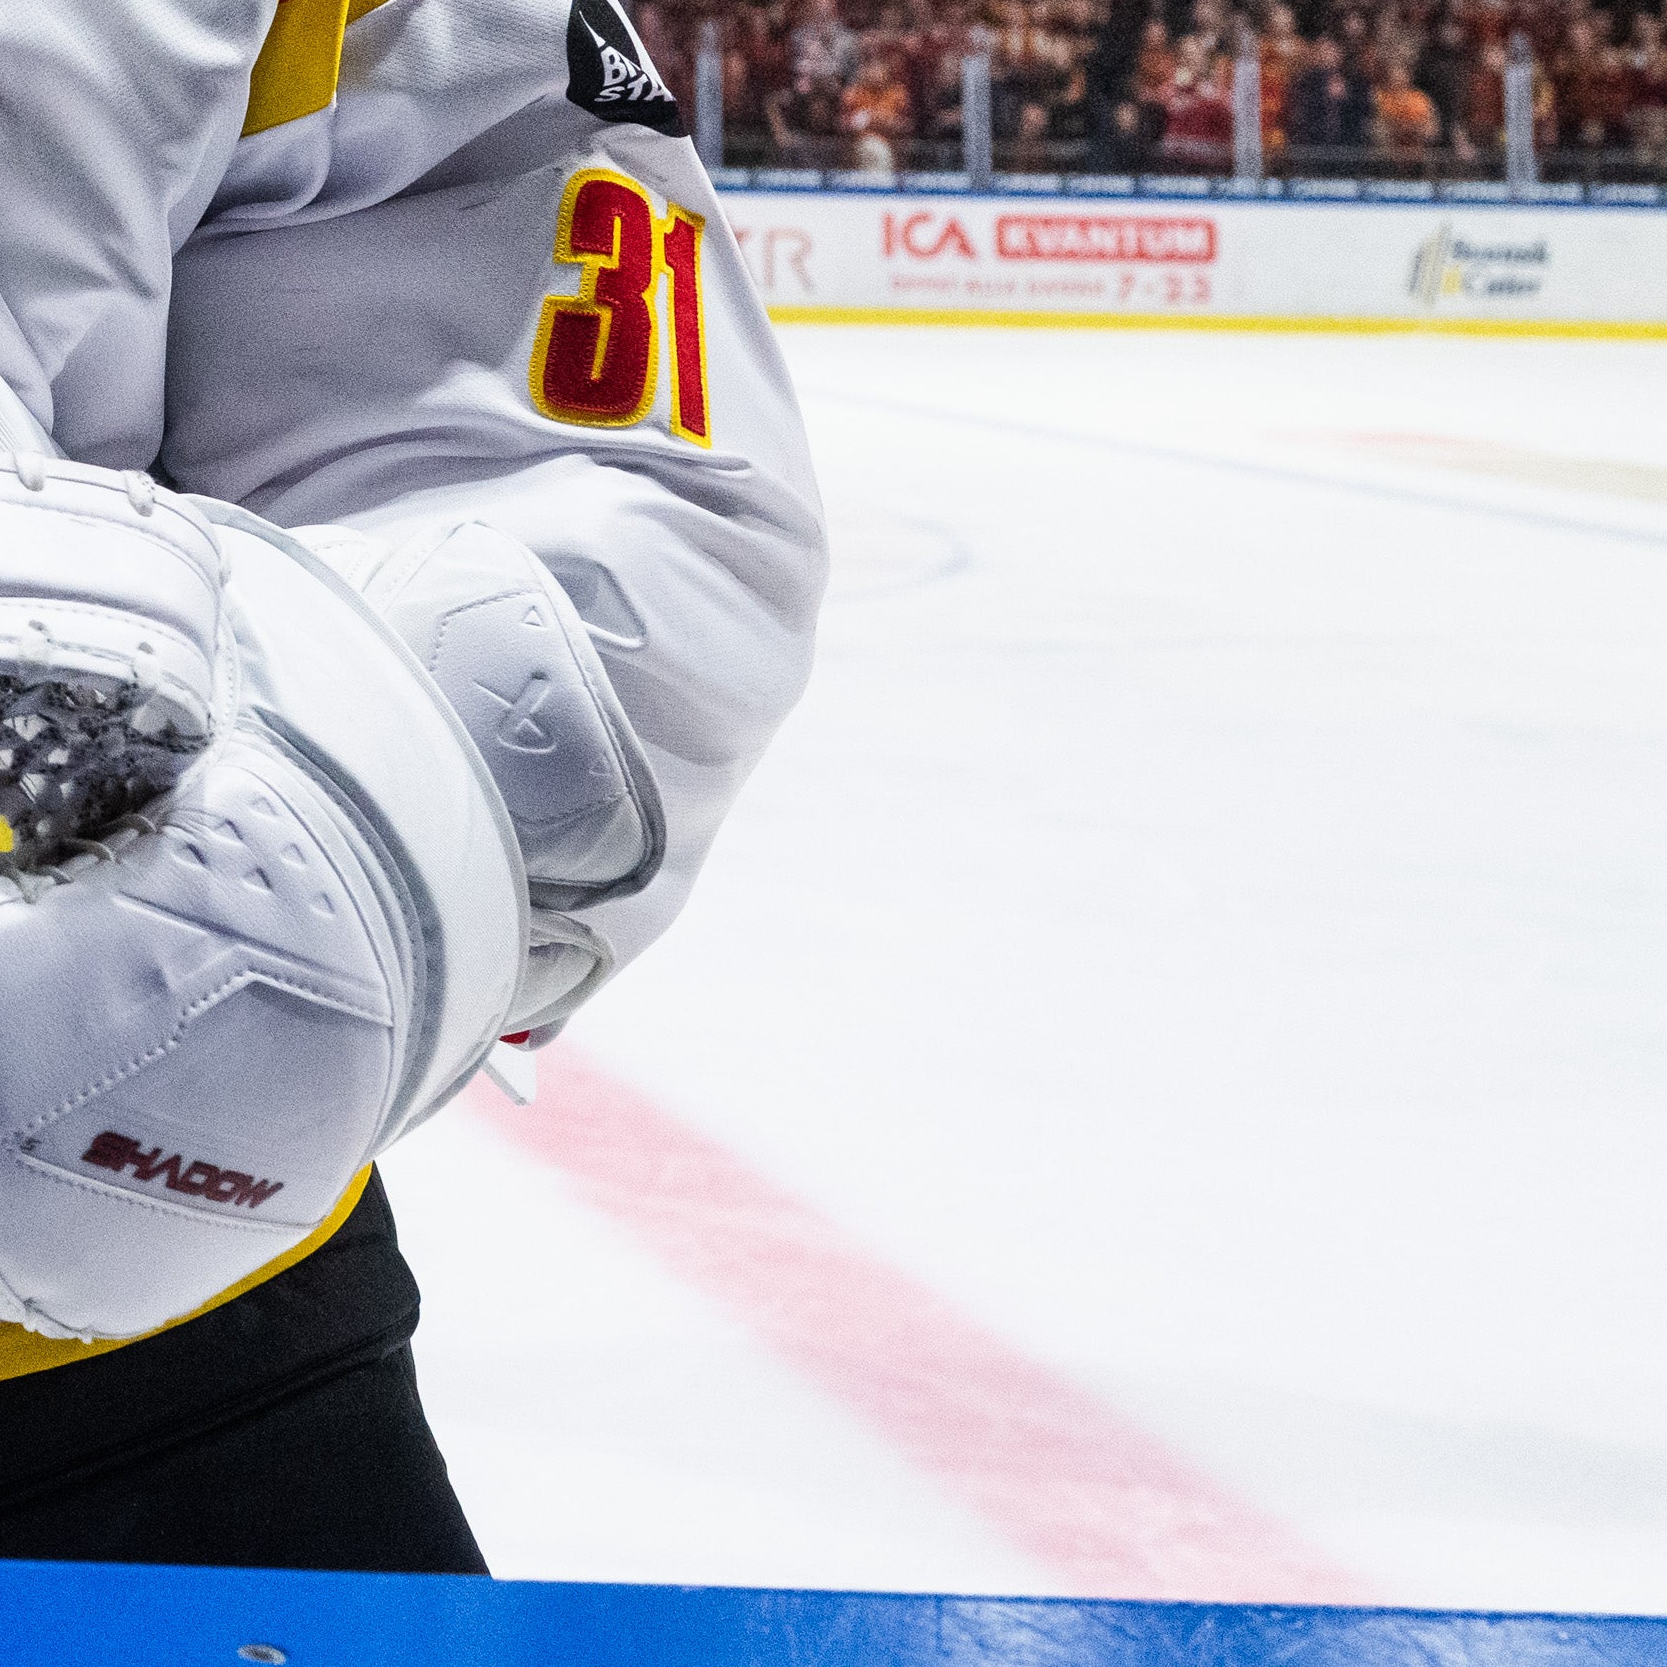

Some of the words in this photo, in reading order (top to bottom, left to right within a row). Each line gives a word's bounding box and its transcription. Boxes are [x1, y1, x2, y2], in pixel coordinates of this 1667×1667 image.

[881, 211, 977, 261] ICA
[1004, 222, 1210, 257] KVANTUM
[528, 168, 712, 449] 31
[81, 1130, 285, 1209] SHADOW
